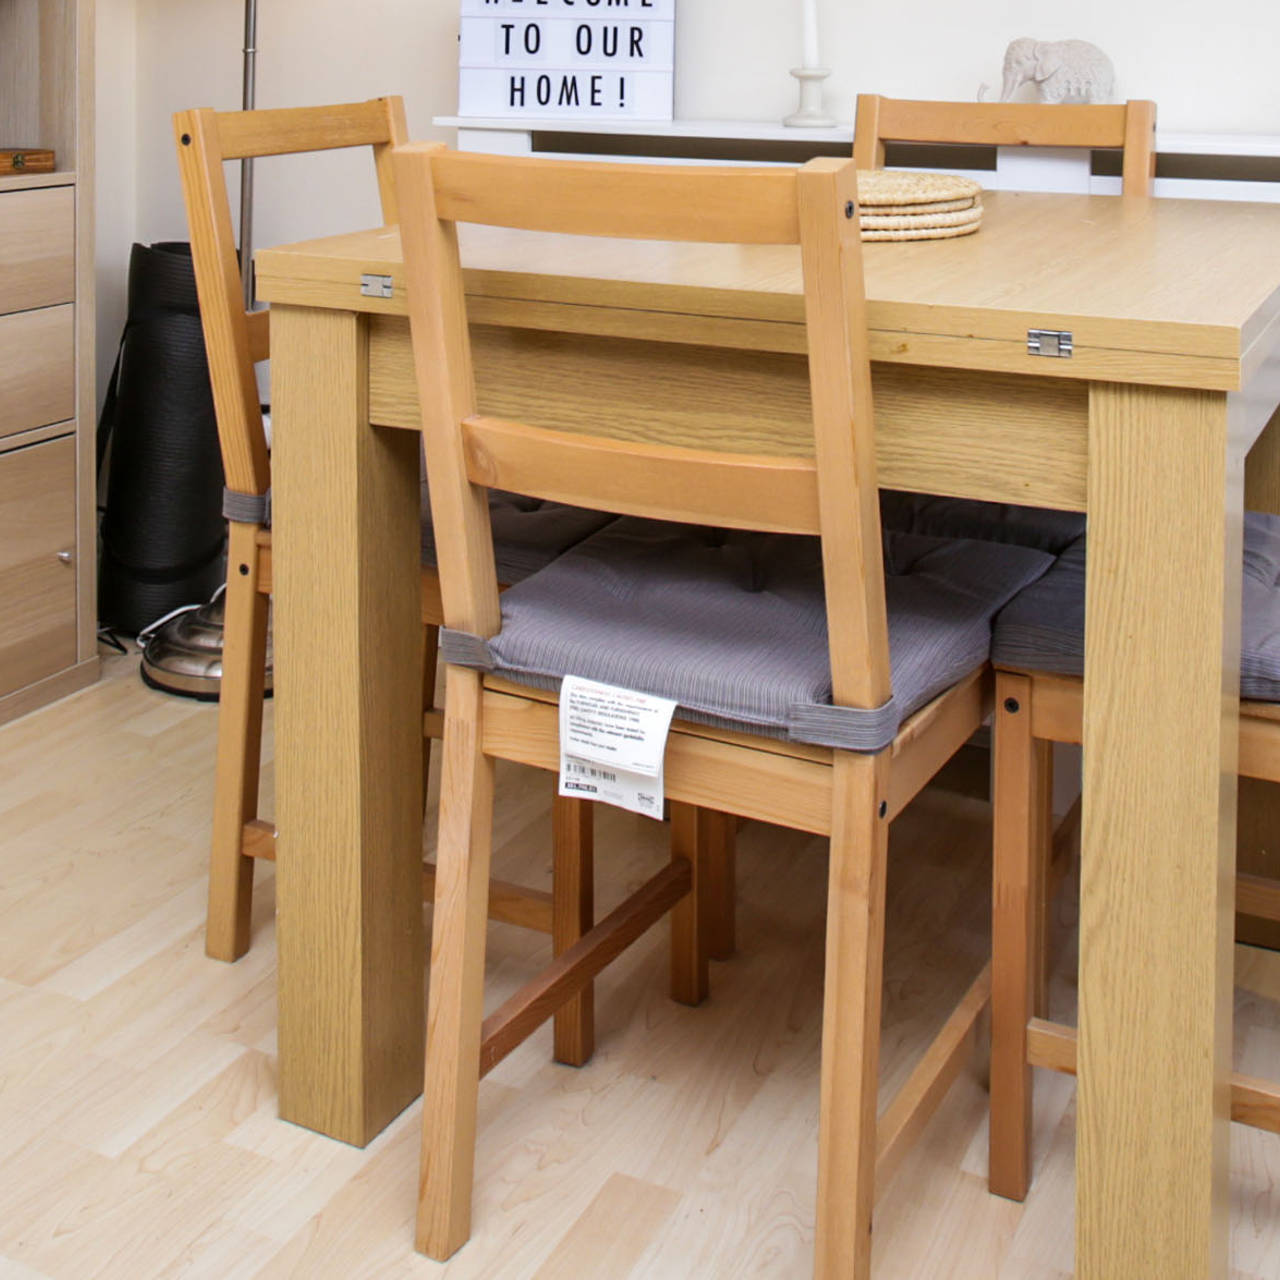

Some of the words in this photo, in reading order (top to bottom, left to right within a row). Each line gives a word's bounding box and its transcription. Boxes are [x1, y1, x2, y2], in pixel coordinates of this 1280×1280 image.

[501, 23, 541, 55] TO
[576, 24, 644, 58] OUR
[510, 75, 625, 108] HOME!
